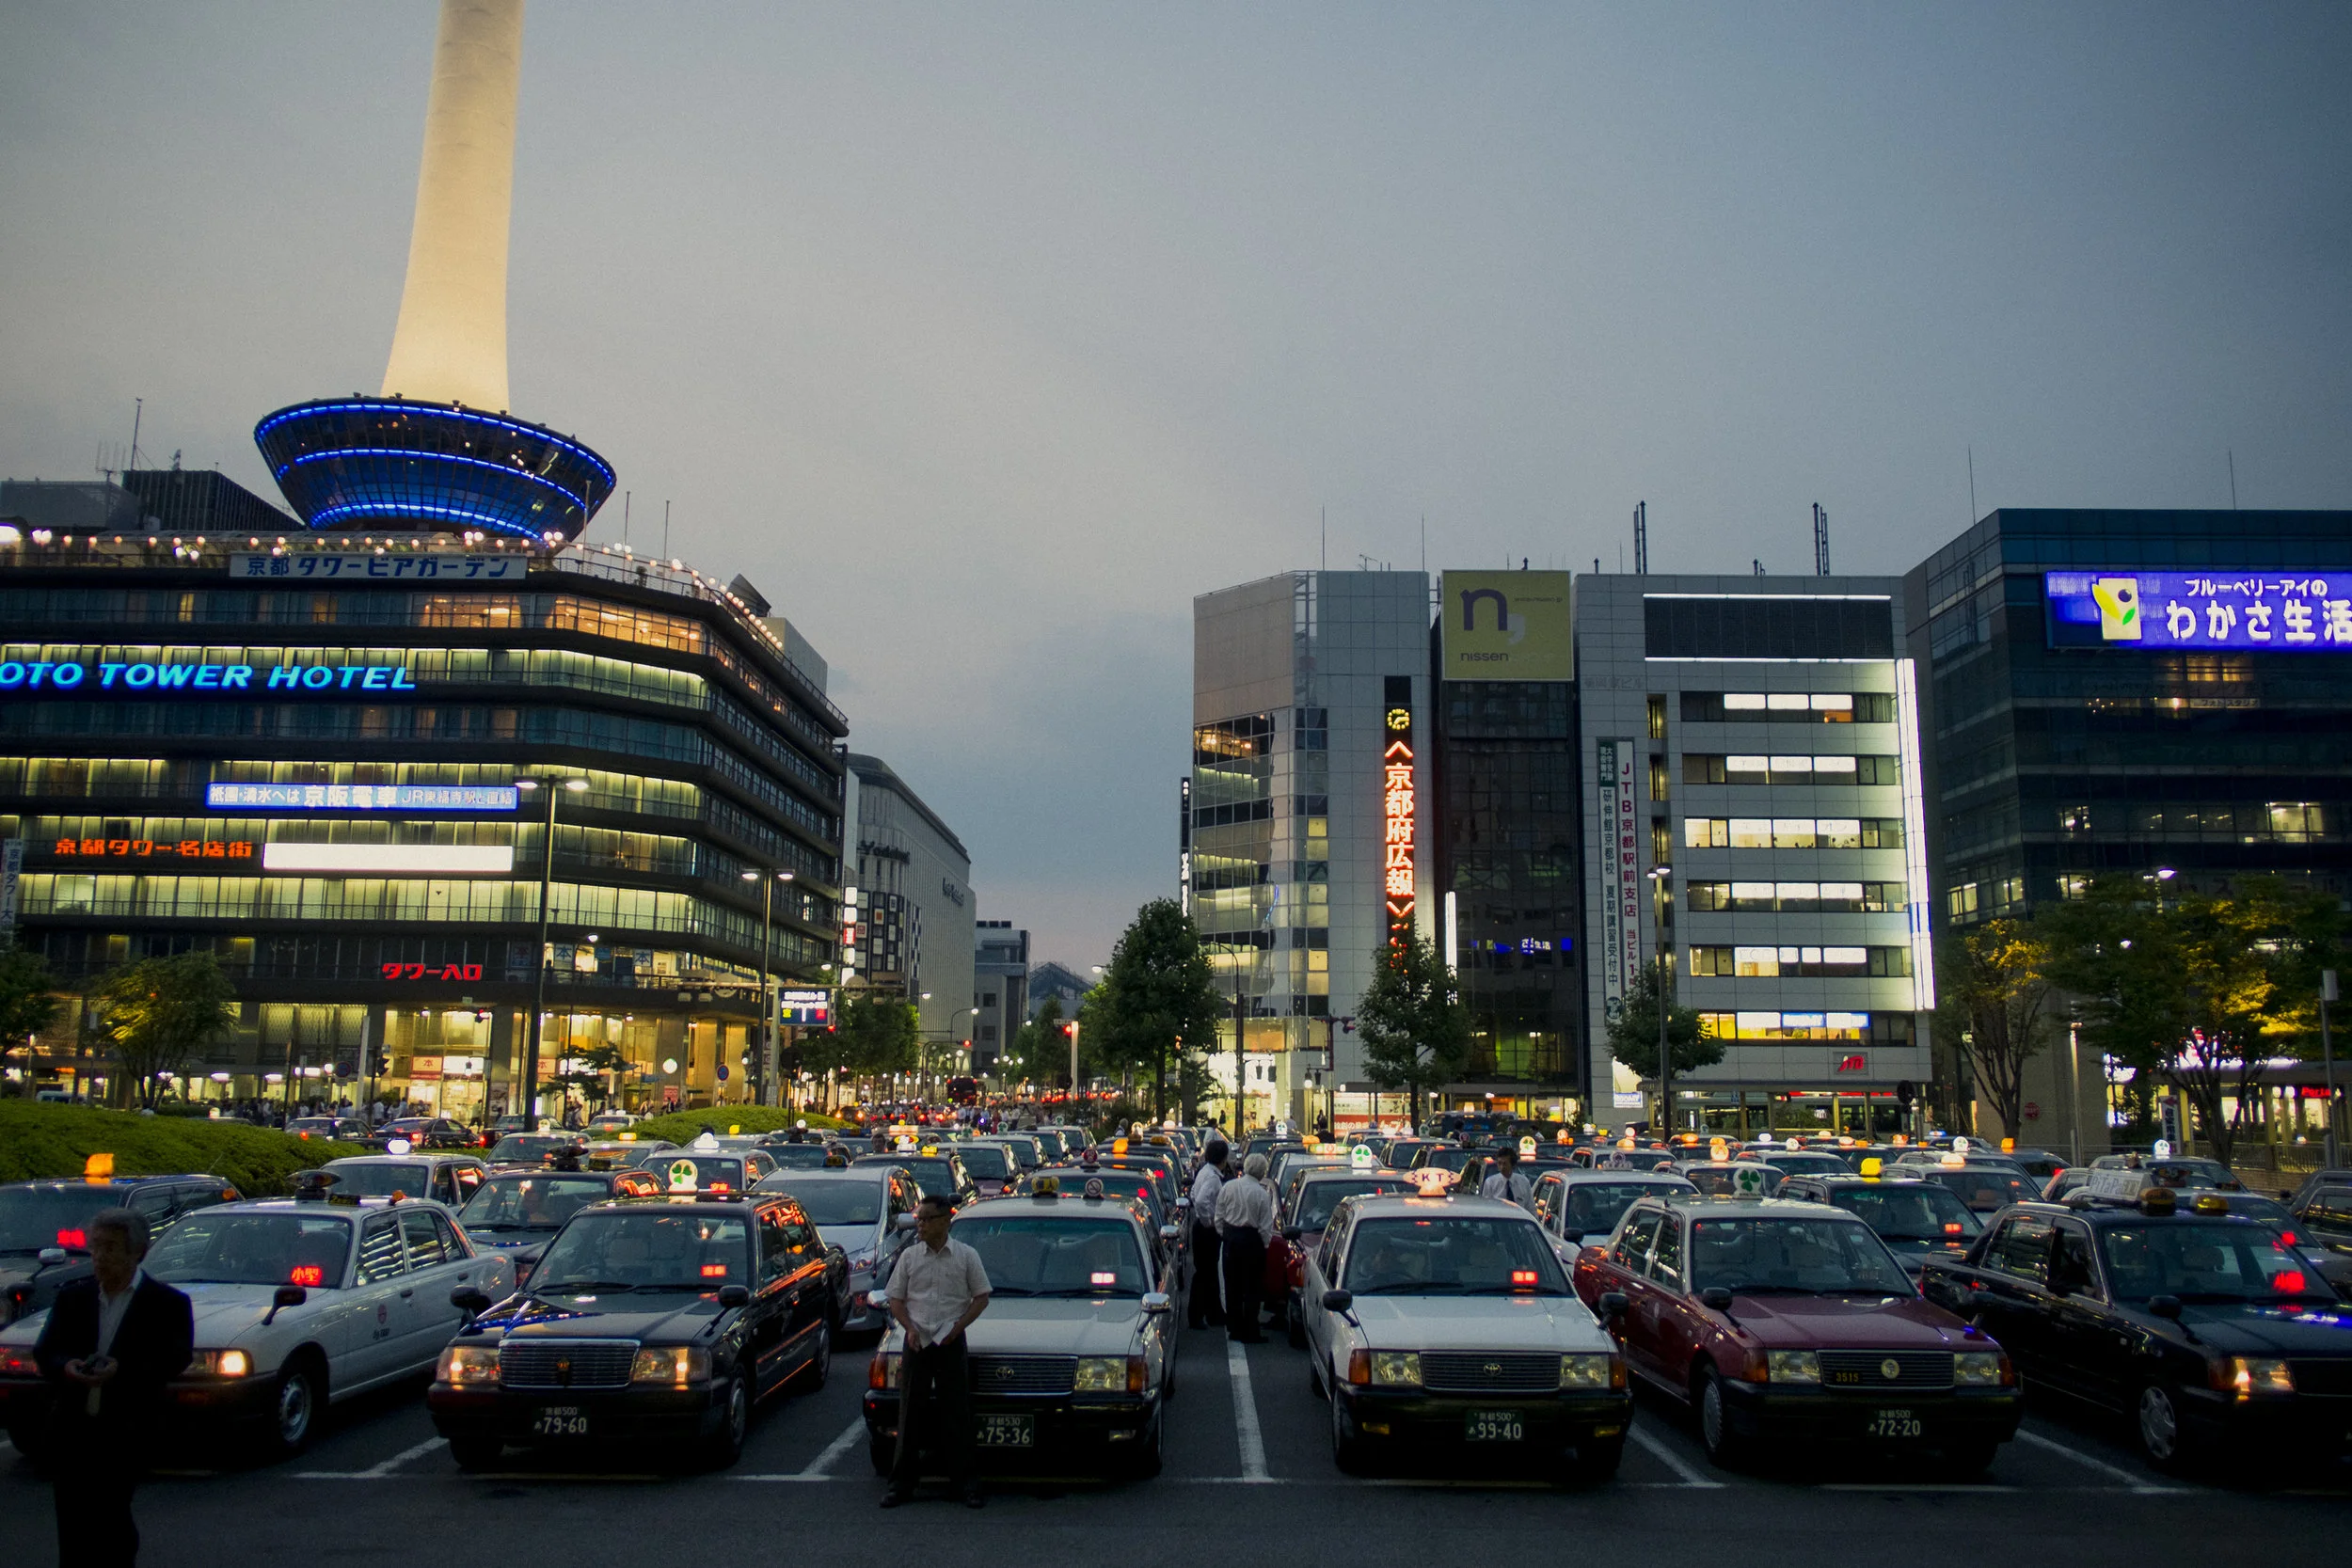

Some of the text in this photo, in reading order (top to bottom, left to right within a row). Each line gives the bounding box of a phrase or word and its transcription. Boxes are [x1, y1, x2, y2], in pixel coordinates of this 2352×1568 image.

[2185, 578, 2328, 596] ブルーベリーアイの
[2166, 599, 2352, 641] わかさ生活
[1460, 652, 1509, 662] nissen
[100, 662, 253, 688] TOWER
[268, 665, 416, 689] HOTEL
[54, 838, 253, 858] 京都タワー名店街
[556, 946, 572, 959] 本
[635, 952, 651, 964] 本
[381, 962, 483, 981] タワー入口
[291, 1266, 321, 1285] 小型
[1836, 1372, 1860, 1383] 3515
[543, 1417, 588, 1434] 79-60
[1477, 1421, 1522, 1439] 99-40
[1877, 1418, 1922, 1437] 72-20
[985, 1426, 1031, 1445] 75-36
